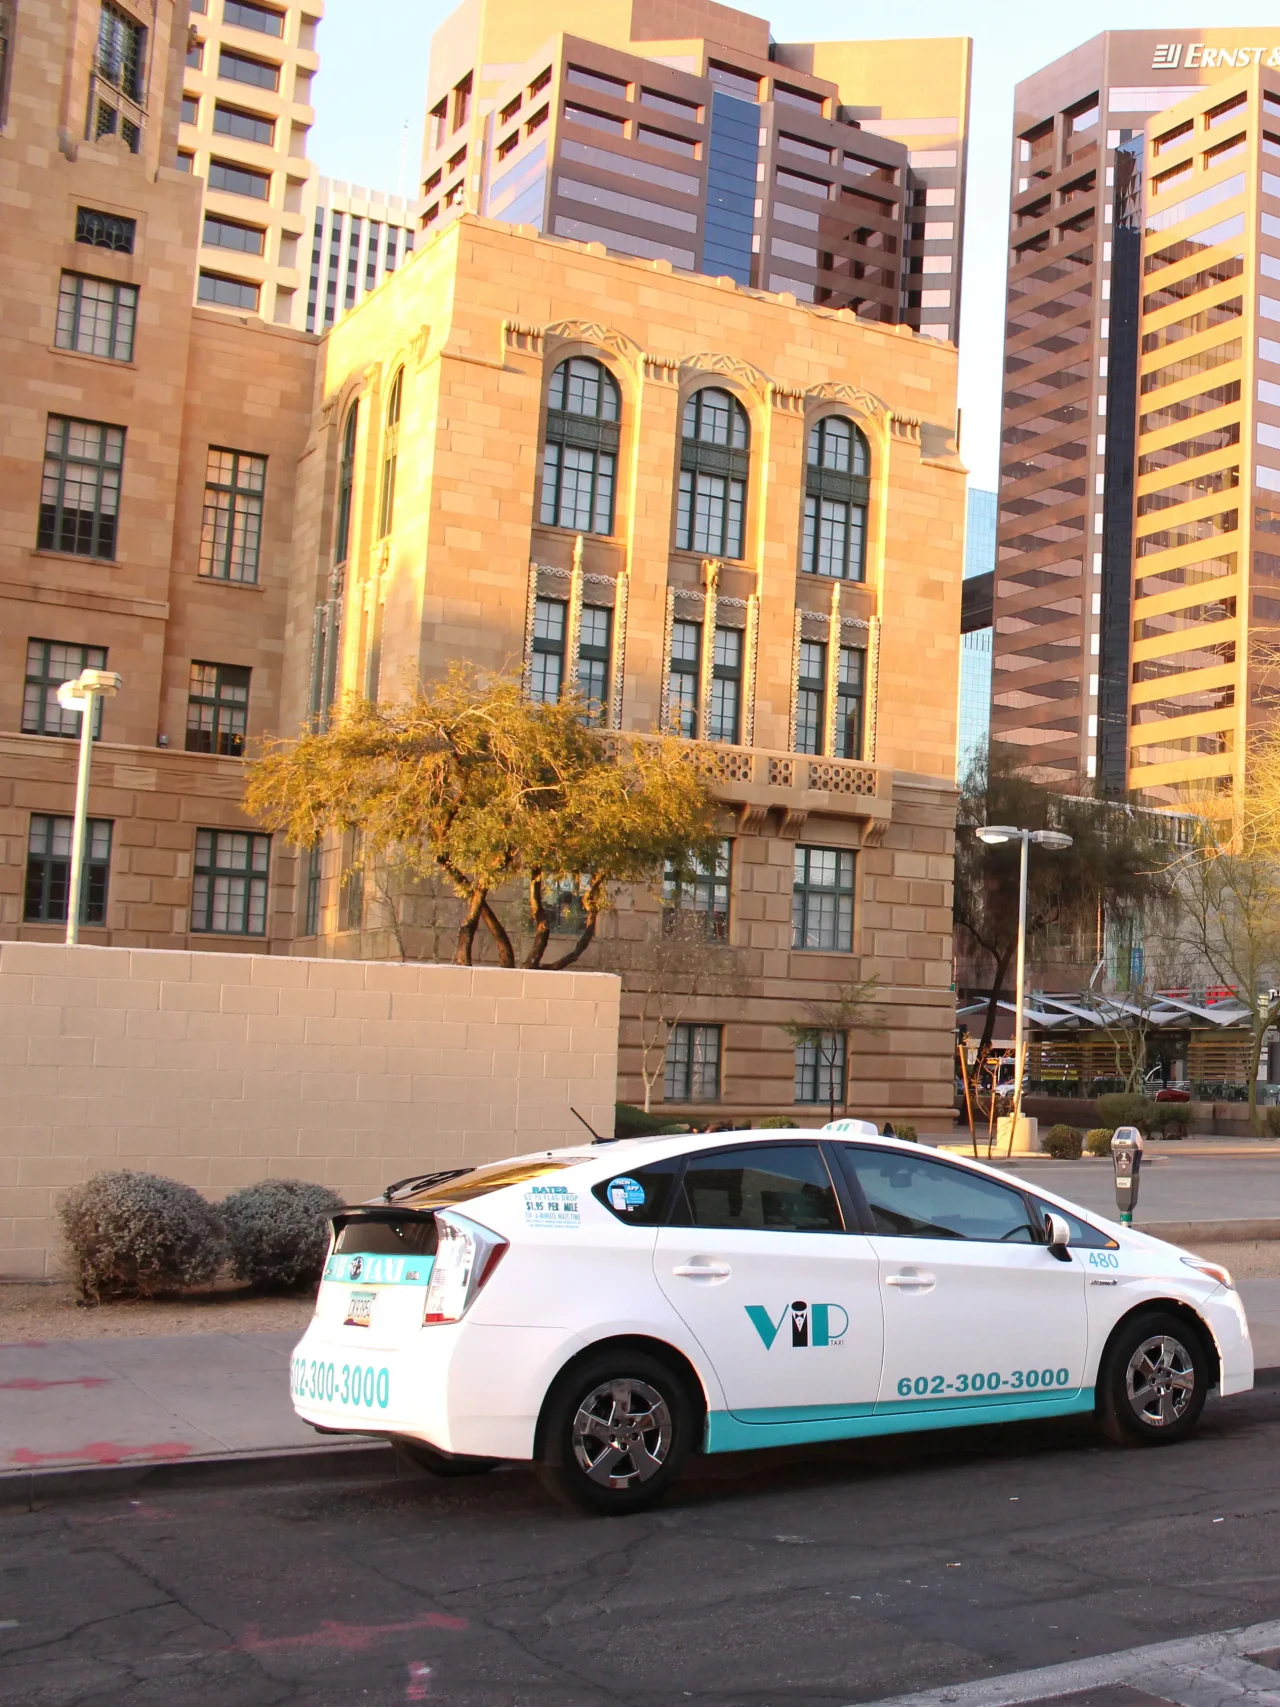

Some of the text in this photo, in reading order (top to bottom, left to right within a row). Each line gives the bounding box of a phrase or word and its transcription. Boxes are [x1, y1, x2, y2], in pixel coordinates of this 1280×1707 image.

[1183, 42, 1267, 68] ERNST
[532, 1186, 568, 1194] RATES
[526, 1202, 579, 1212] $1.95 PER MILE
[363, 1257, 405, 1282] TAXI
[1089, 1252, 1119, 1268] 480
[290, 1358, 389, 1409] 02-300-3000
[897, 1368, 1070, 1396] 602-300-3000
